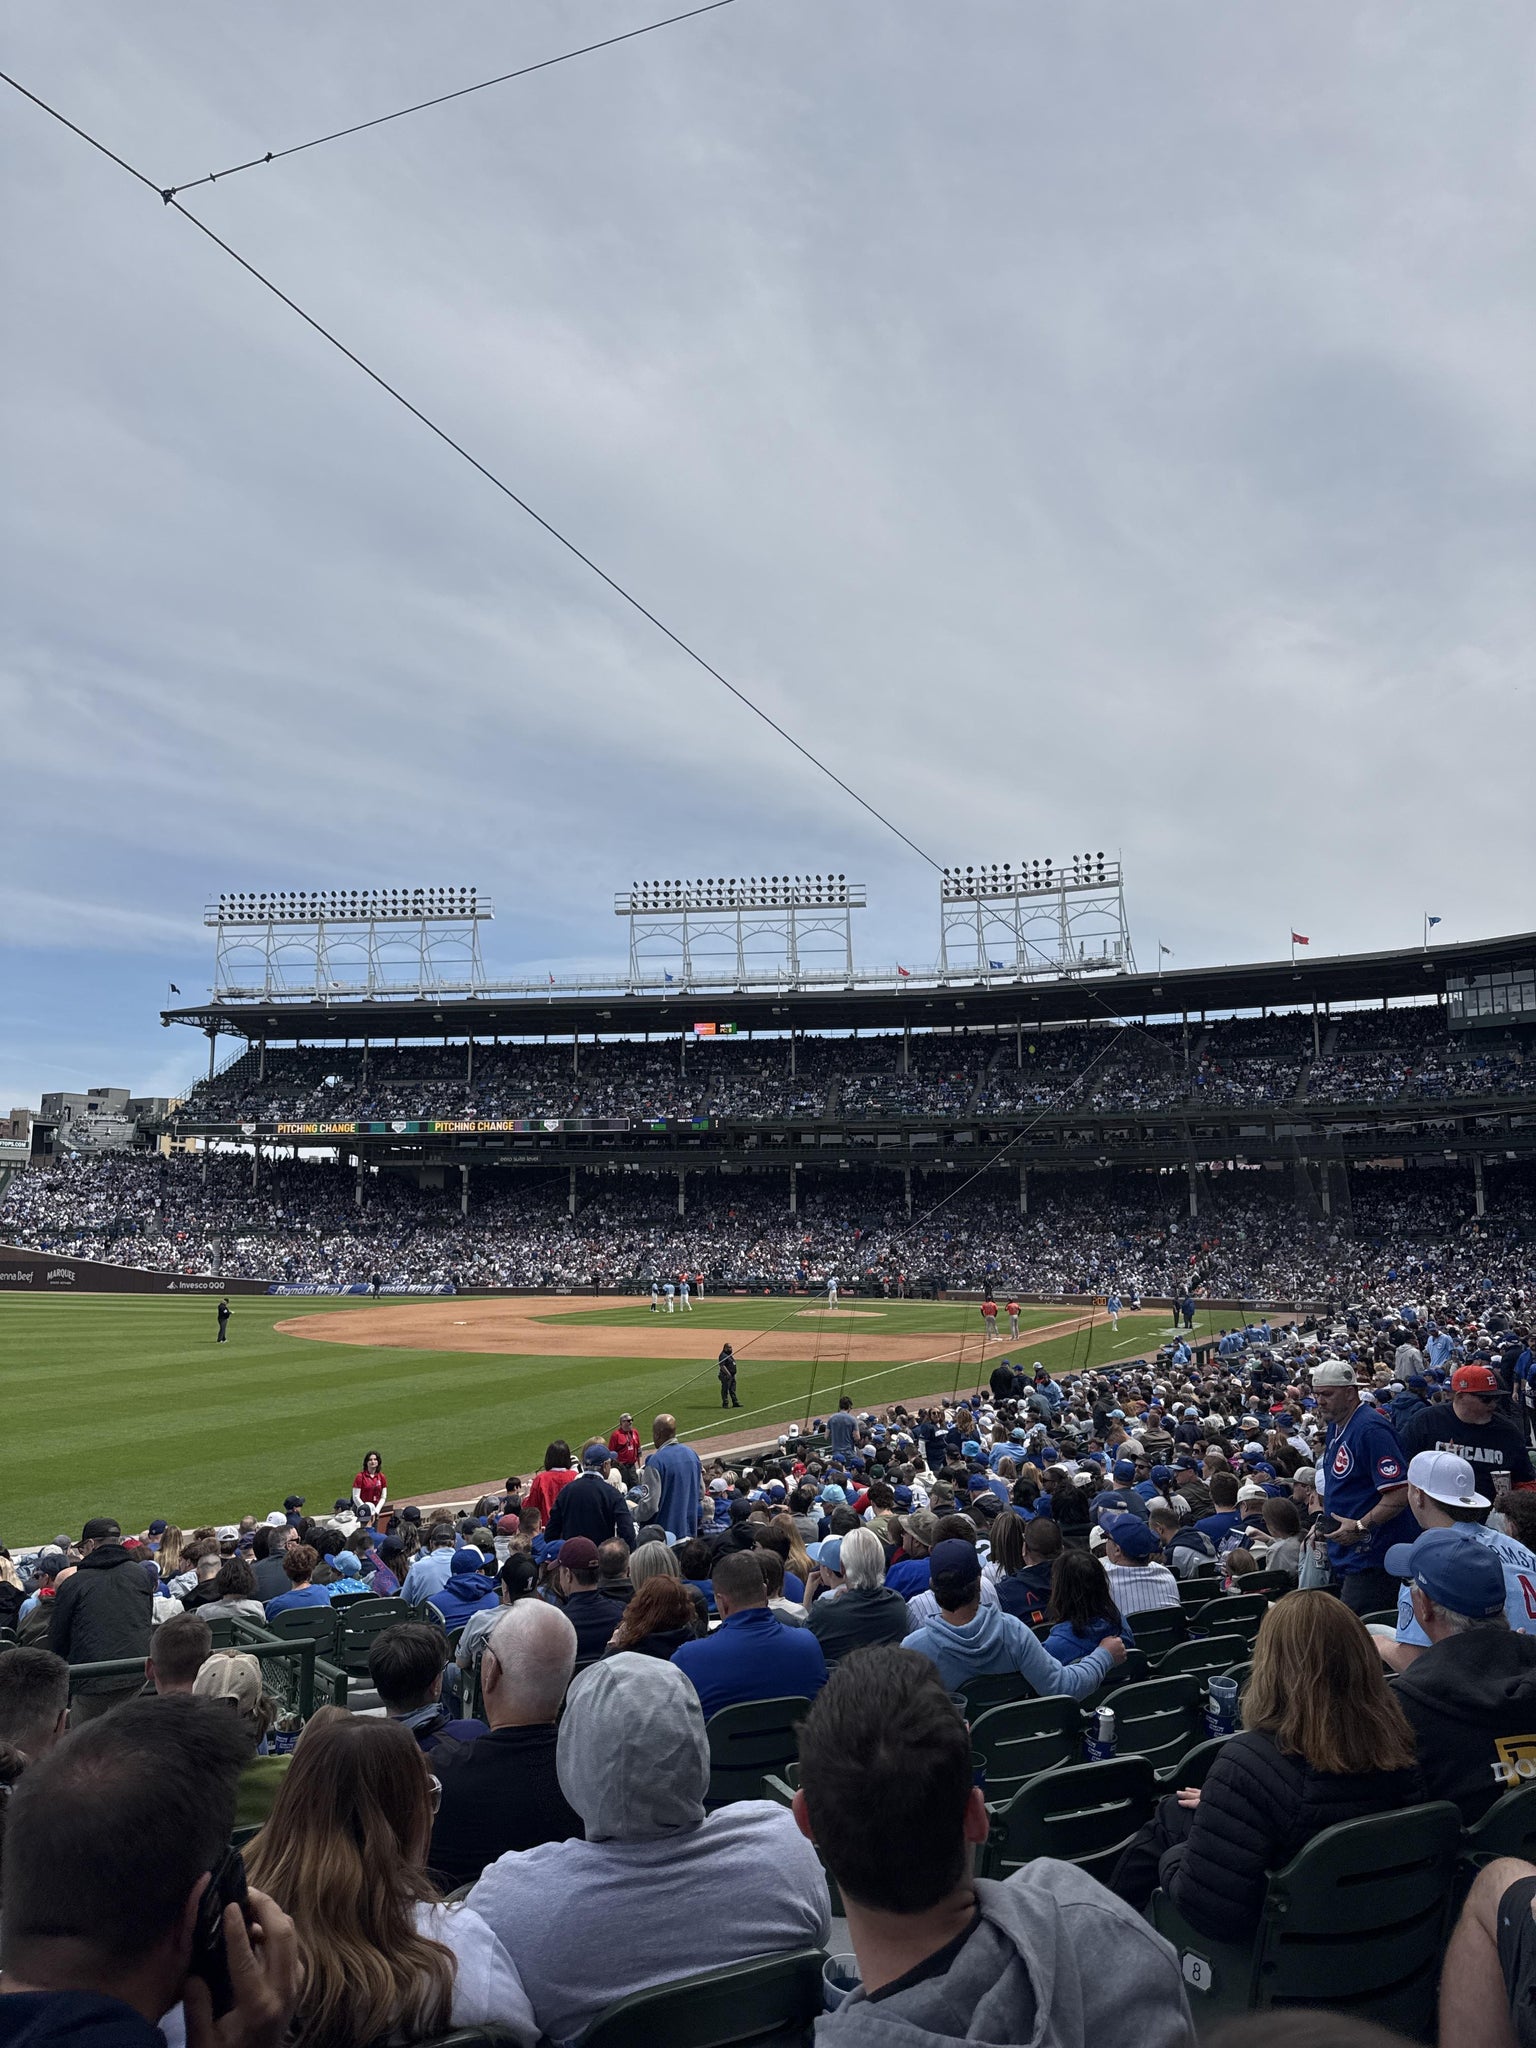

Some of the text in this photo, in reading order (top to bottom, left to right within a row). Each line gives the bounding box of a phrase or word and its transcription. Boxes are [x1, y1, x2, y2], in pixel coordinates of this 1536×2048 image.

[277, 1123, 356, 1133] PITCHING CHANGE
[434, 1121, 514, 1131] PITCHING CHANGE
[17, 1270, 34, 1284] Beef
[47, 1268, 76, 1281] MARQUEE
[179, 1281, 225, 1290] Invesco QQQ
[274, 1285, 340, 1296] Reynolds Wrap
[365, 1284, 432, 1294] Rynolds Wrap
[1192, 1962, 1201, 1981] 8
